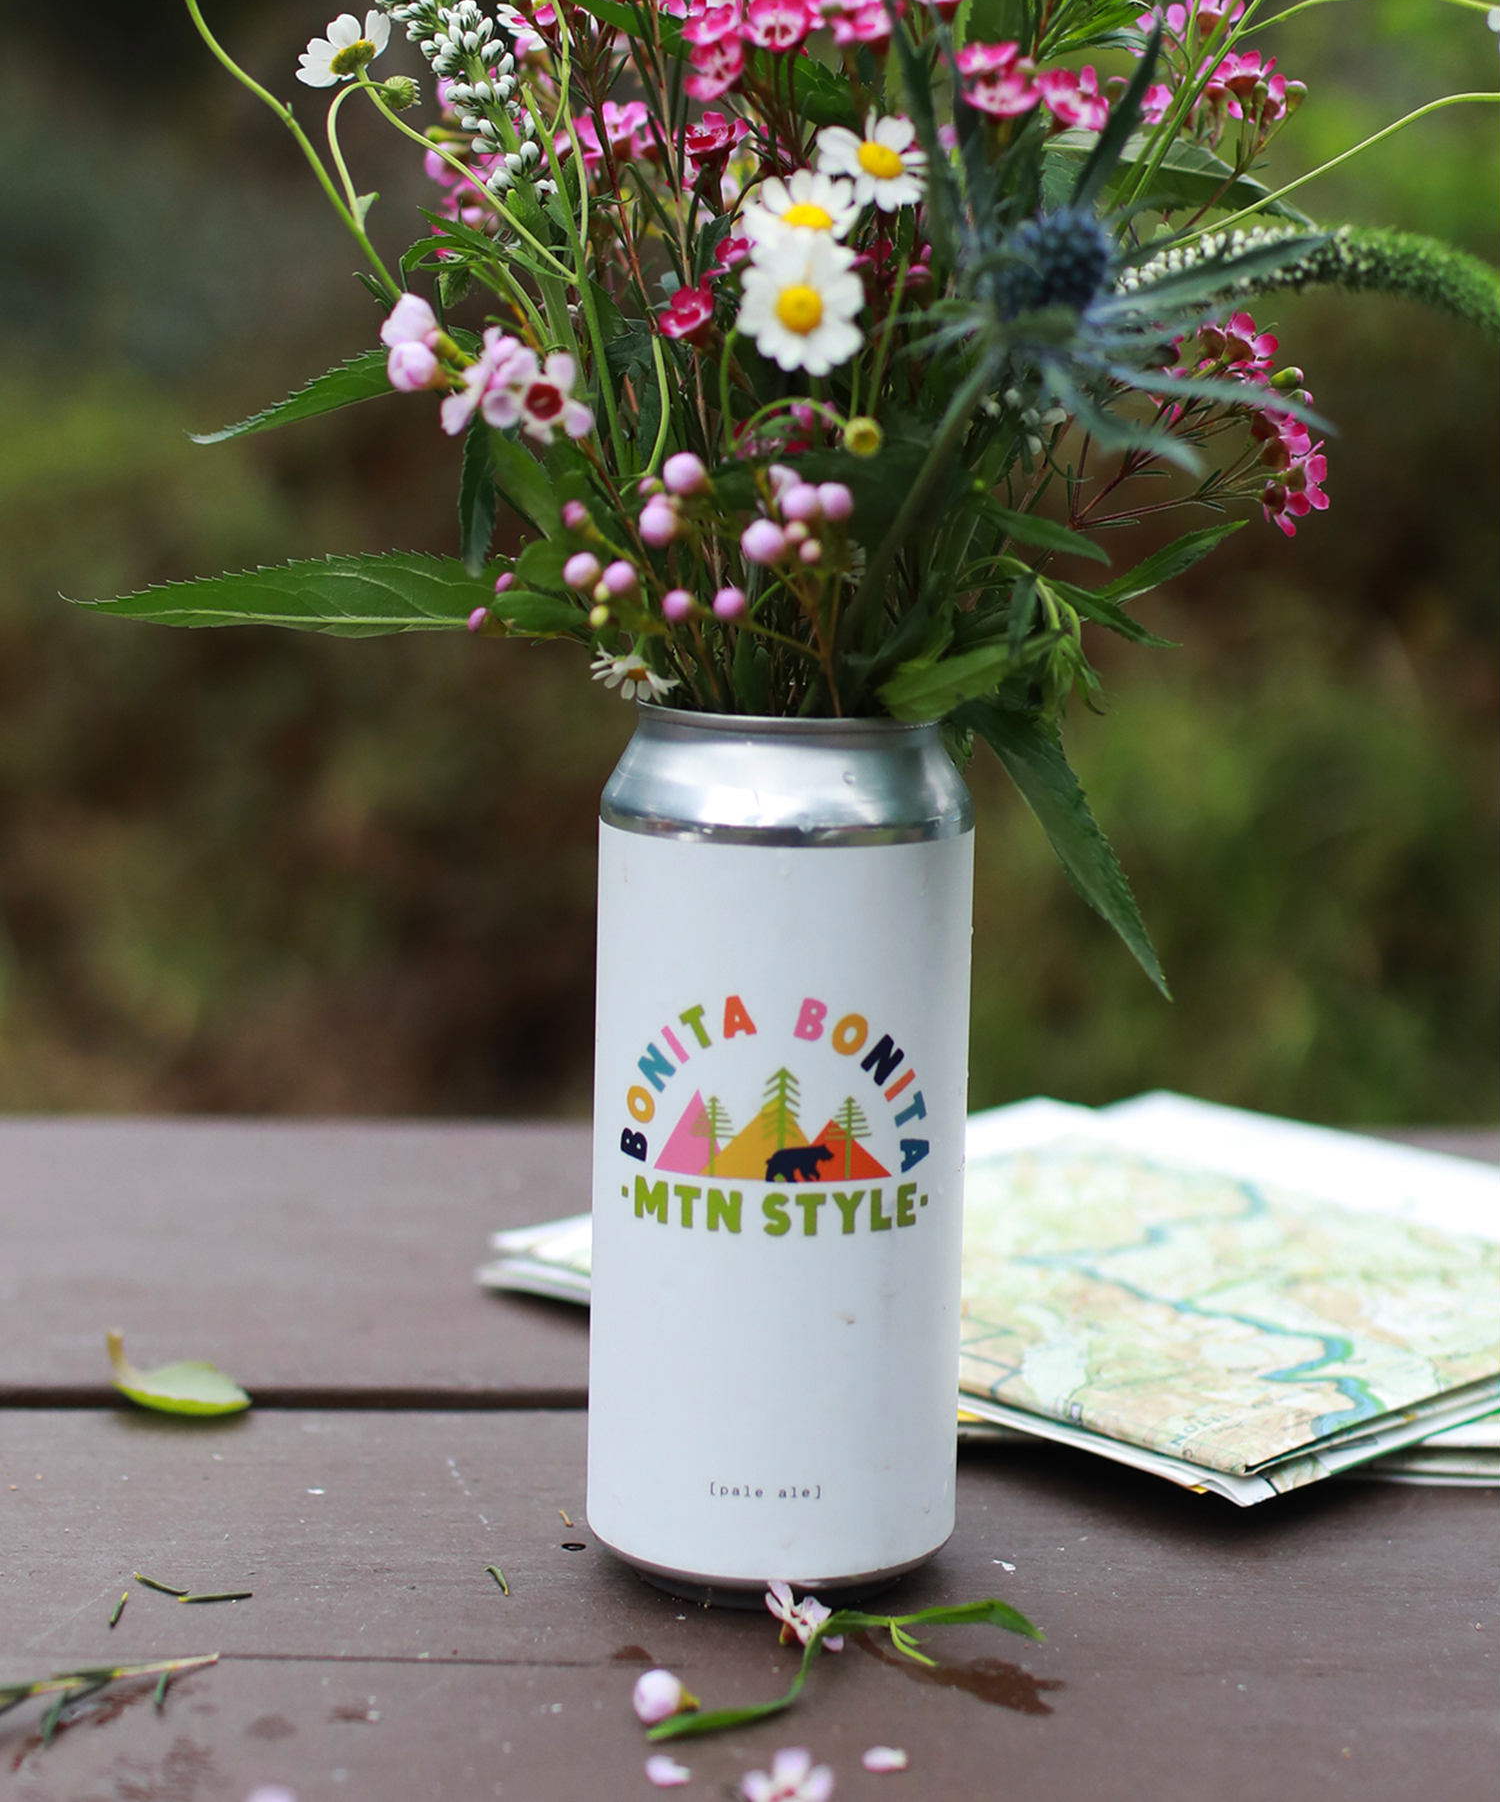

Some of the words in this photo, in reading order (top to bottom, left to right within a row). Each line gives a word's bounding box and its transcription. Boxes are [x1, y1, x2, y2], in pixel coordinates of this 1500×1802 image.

[619, 994, 758, 1163] BONITA
[793, 997, 931, 1174] BONITA
[633, 1174, 743, 1235] MTN
[760, 1181, 918, 1237] STYLE
